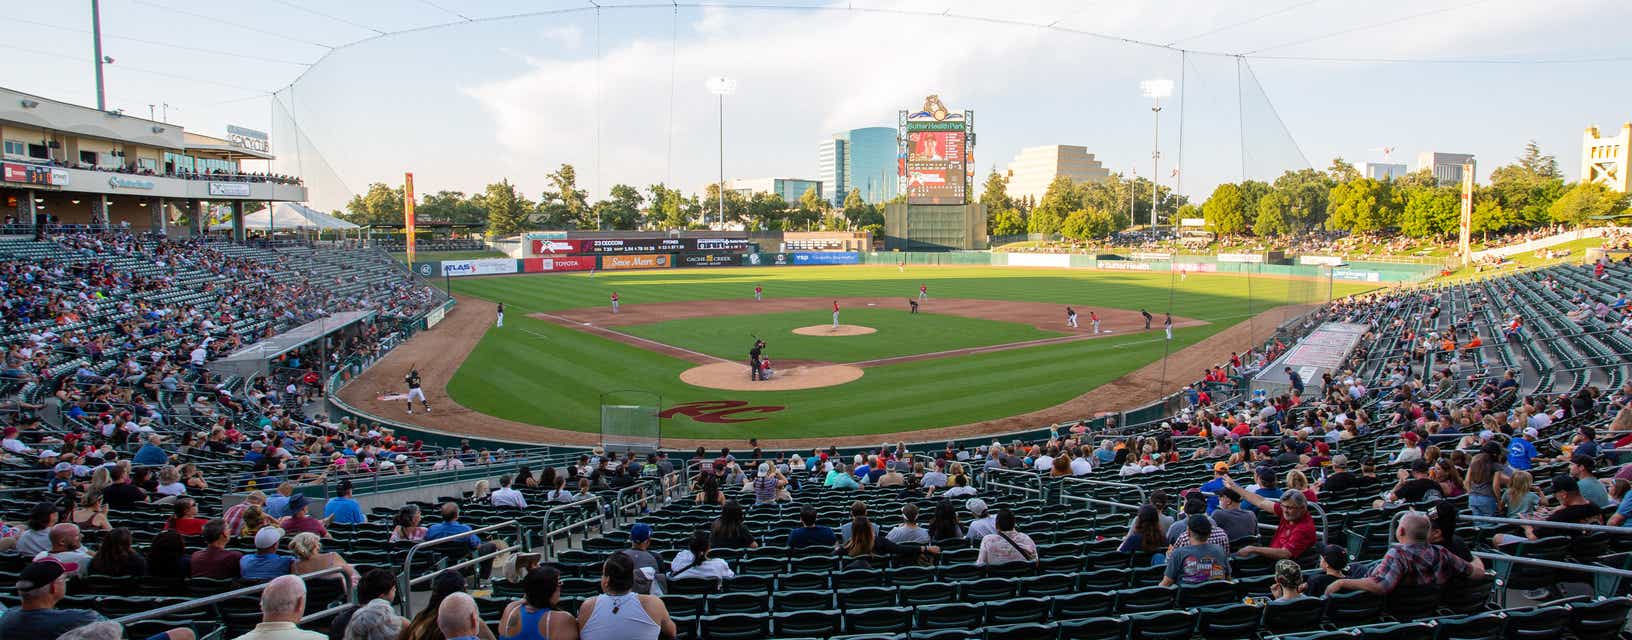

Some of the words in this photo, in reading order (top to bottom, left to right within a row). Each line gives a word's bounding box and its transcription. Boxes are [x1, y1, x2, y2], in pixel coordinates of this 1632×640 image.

[612, 257, 630, 265] Save
[632, 257, 653, 266] Mart
[445, 264, 470, 272] ATLAS
